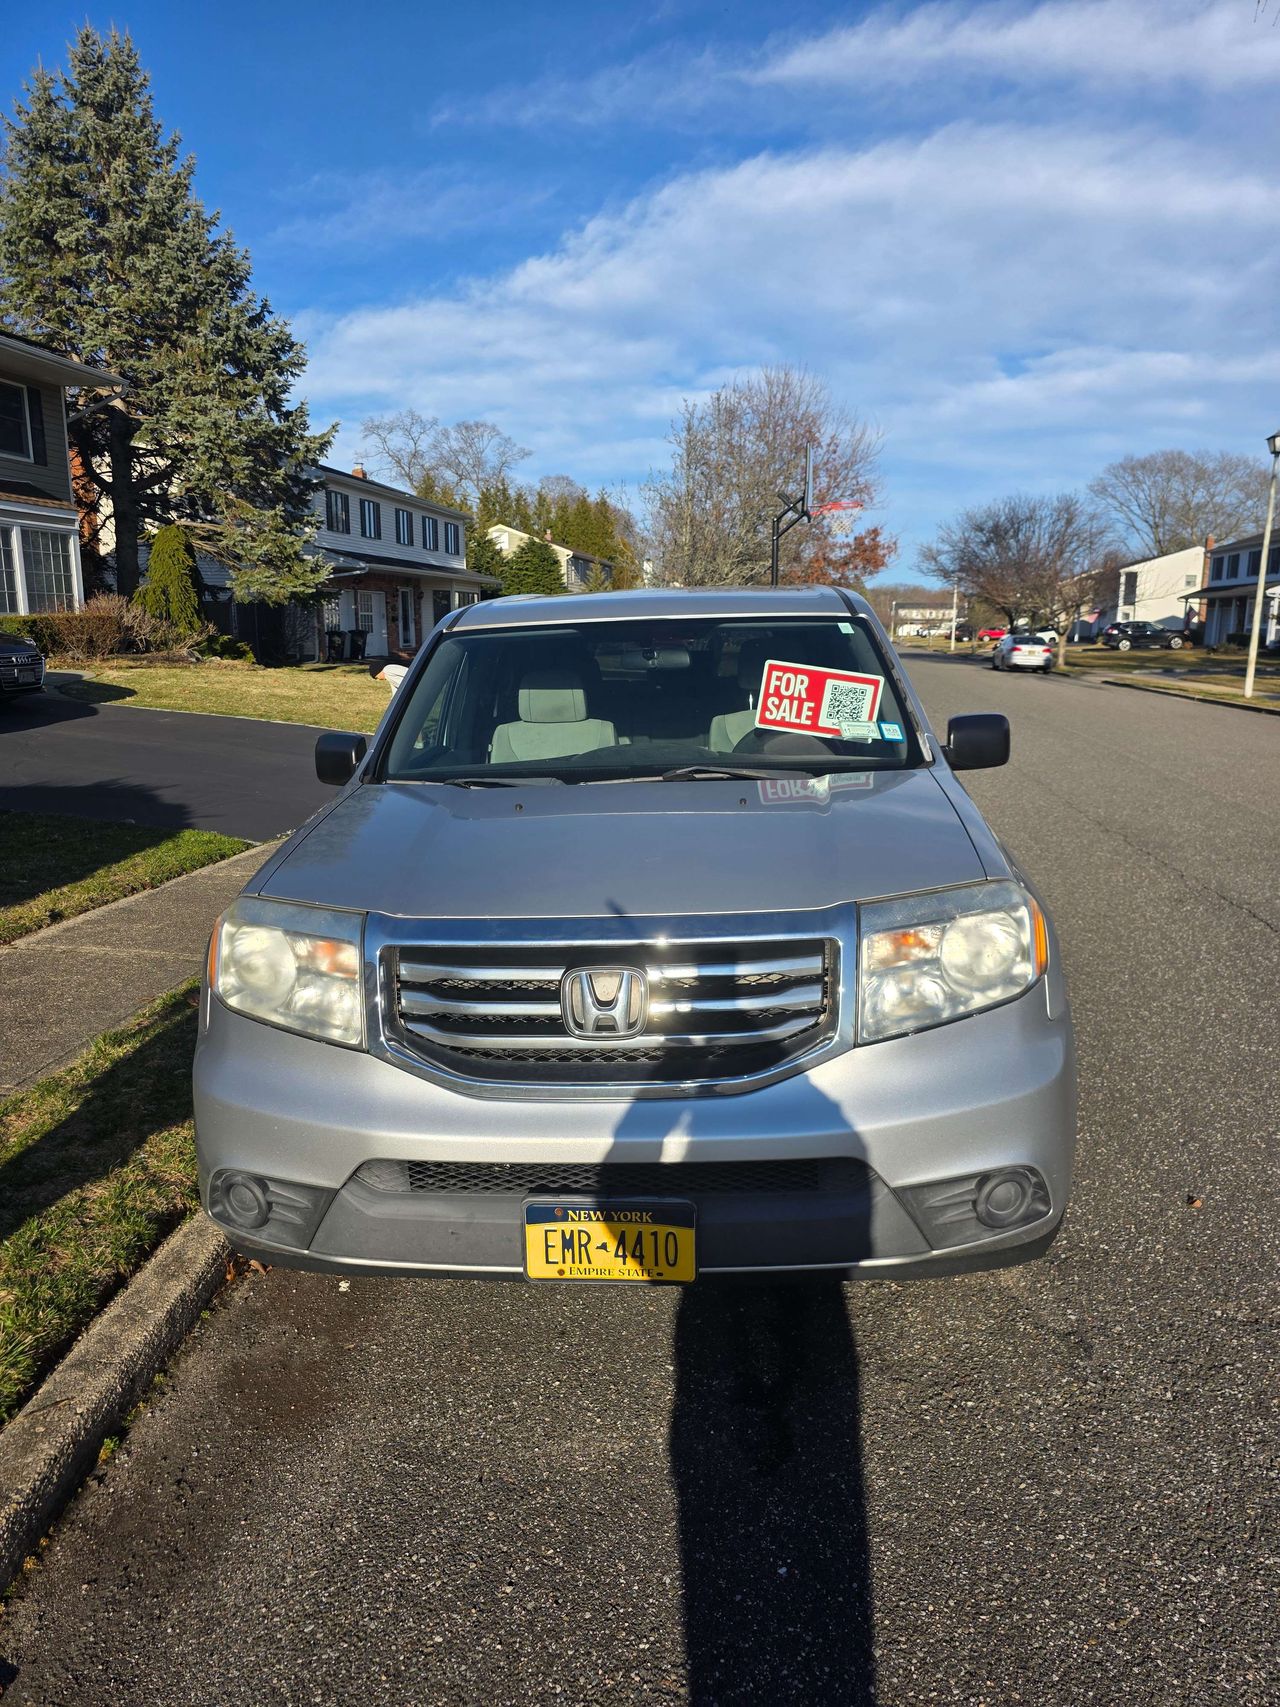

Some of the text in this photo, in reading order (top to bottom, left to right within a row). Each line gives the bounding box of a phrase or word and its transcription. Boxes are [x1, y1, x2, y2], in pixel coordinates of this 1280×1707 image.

[769, 671, 809, 698] FOR
[765, 697, 815, 725] SALE
[568, 1210, 653, 1223] NEW YORK
[544, 1229, 679, 1267] EMR 4410
[569, 1267, 654, 1278] EMPIRE STATE
